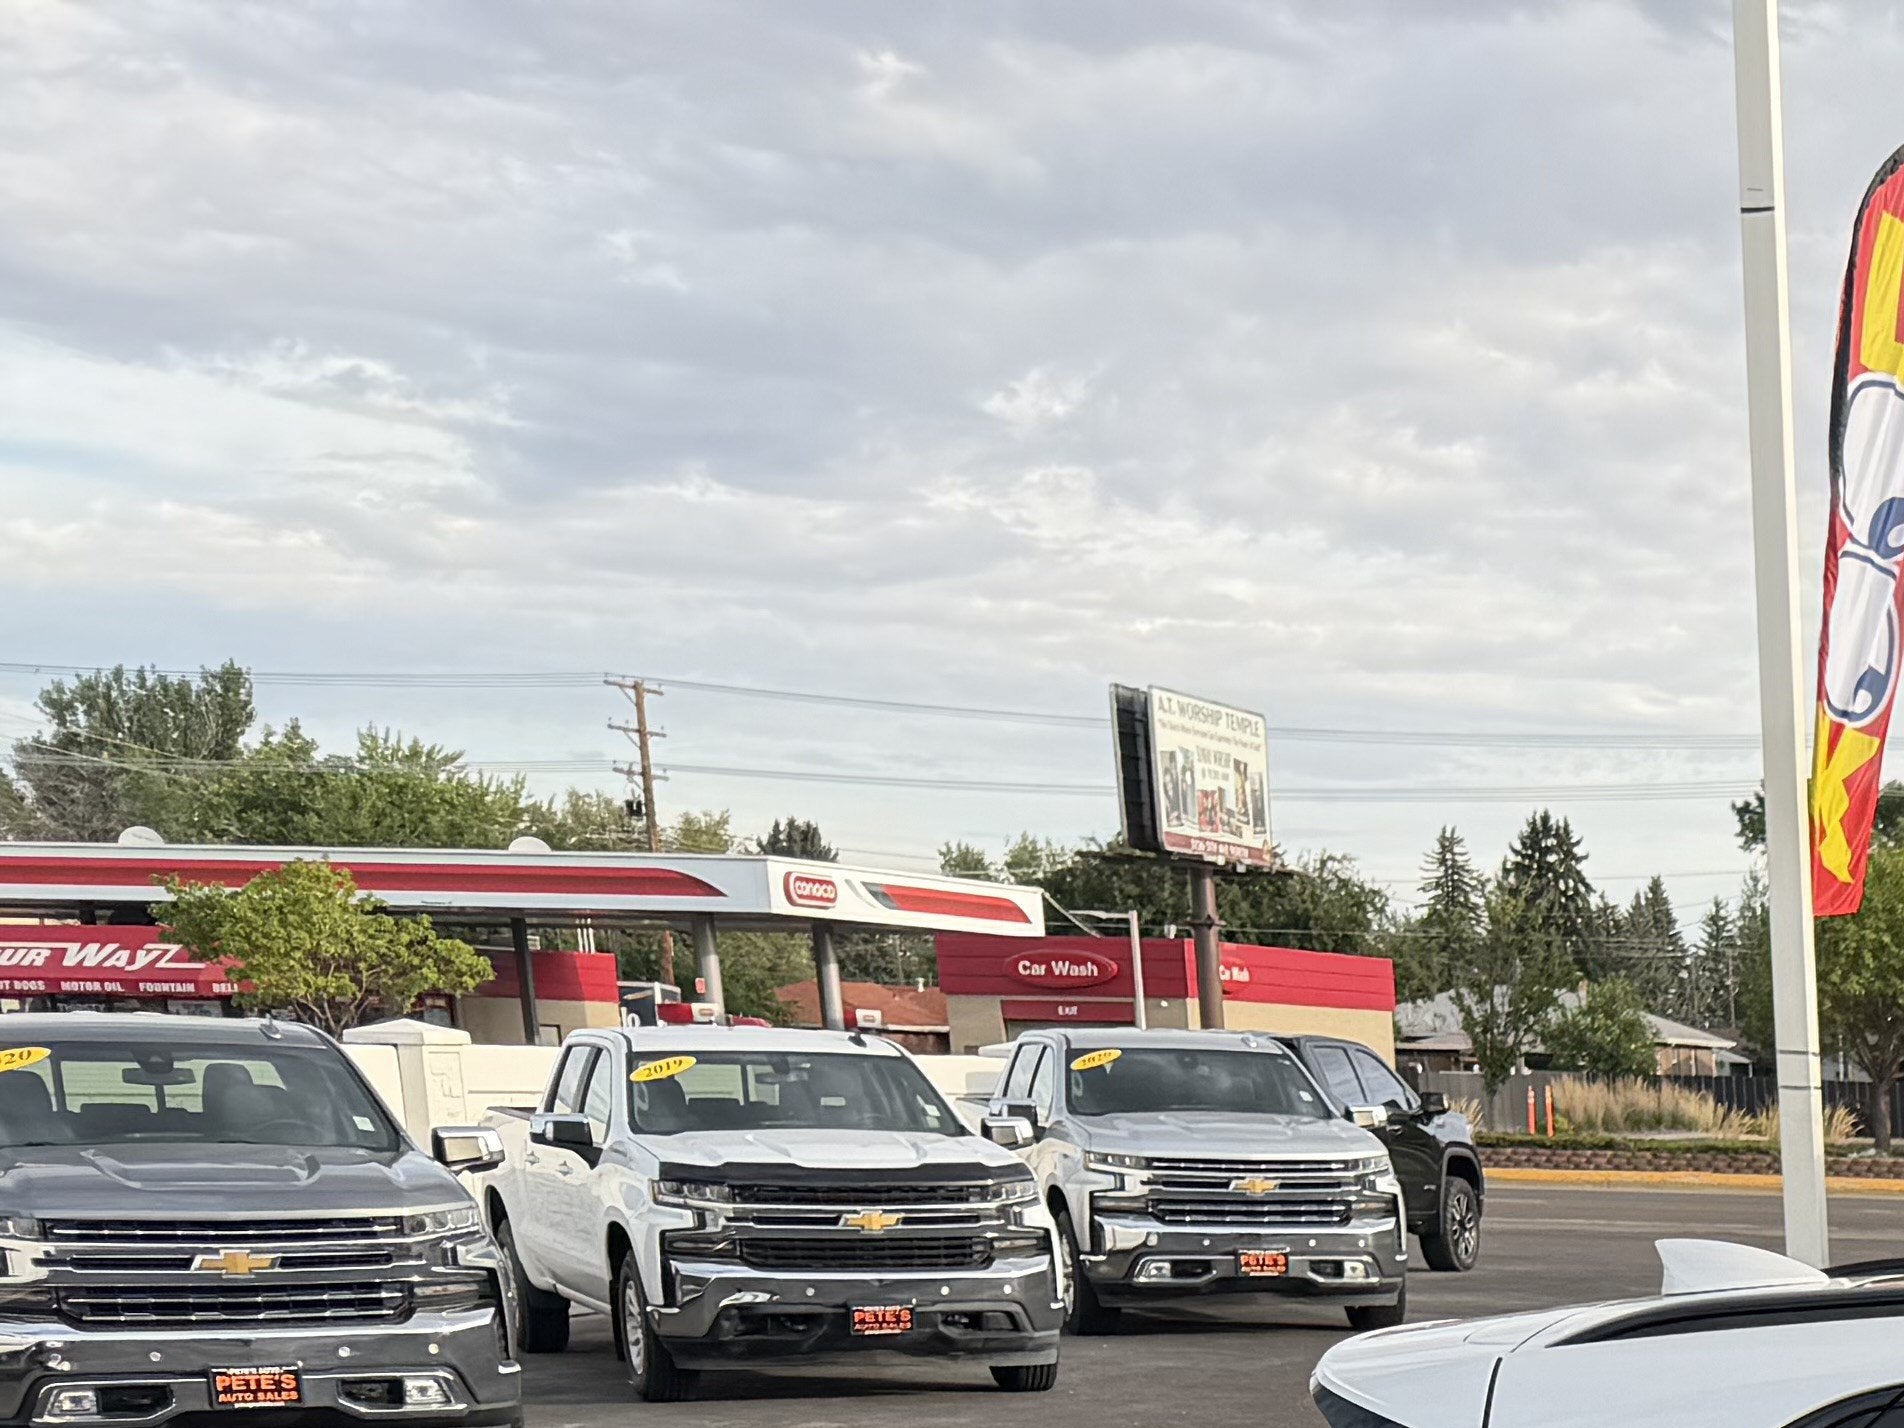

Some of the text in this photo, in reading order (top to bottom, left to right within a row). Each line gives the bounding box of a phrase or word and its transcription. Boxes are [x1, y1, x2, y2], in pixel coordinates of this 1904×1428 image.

[1225, 711, 1260, 738] TEMPLE
[1018, 960, 1099, 977] Car Wash
[13, 980, 46, 991] DOGS
[60, 981, 102, 992] MOTOR
[104, 981, 125, 992] OIL
[139, 982, 195, 993] FOUNTAIN
[643, 1059, 683, 1078] 2019
[216, 1374, 298, 1391] PETE'S
[218, 1391, 299, 1403] AUTO SALES
